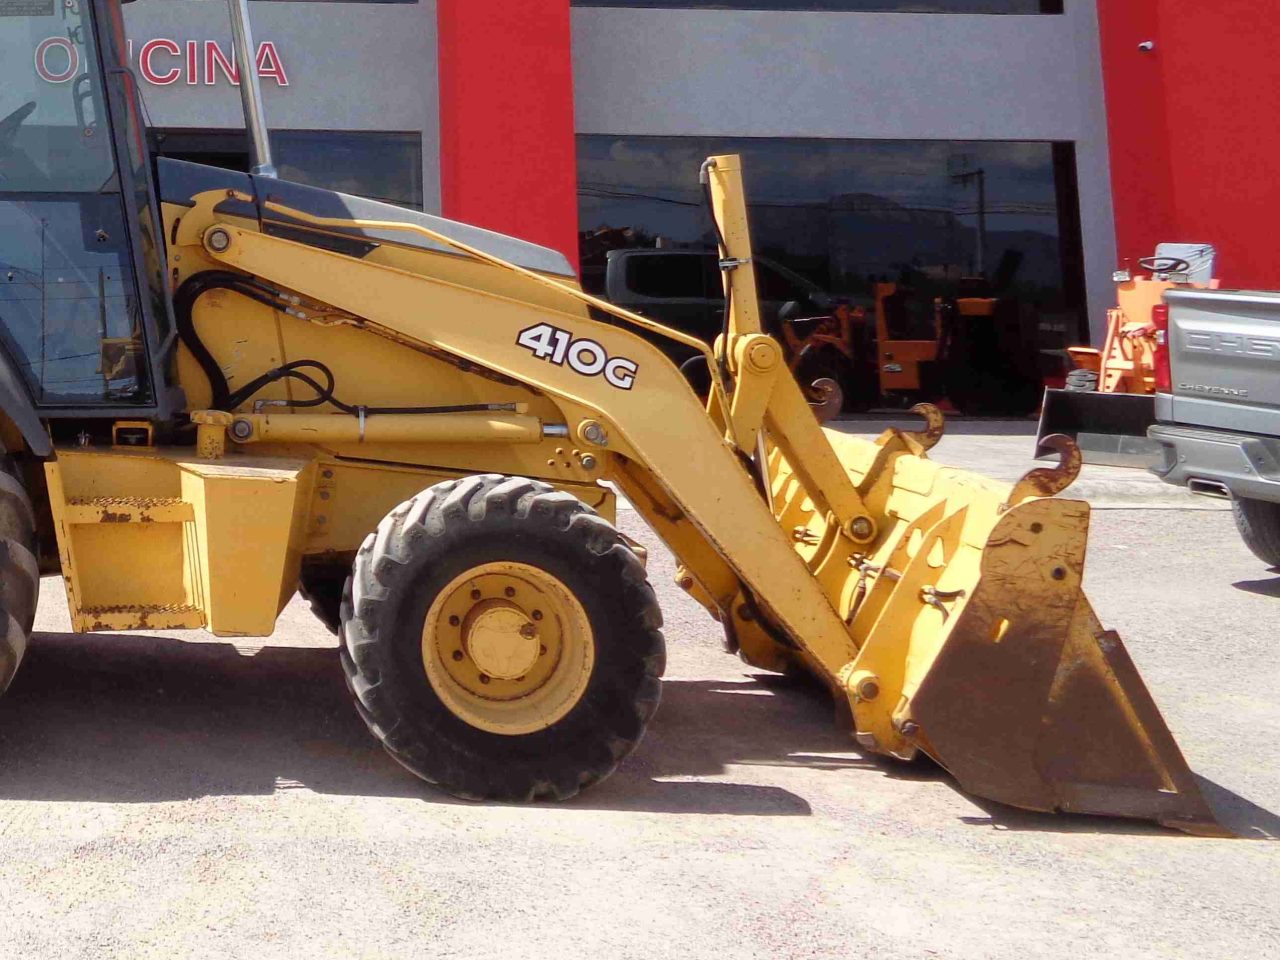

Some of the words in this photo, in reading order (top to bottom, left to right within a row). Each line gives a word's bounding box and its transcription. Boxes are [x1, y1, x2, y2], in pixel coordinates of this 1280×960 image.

[35, 36, 289, 86] OCINA
[516, 321, 639, 390] 410G
[1185, 331, 1280, 357] CHE
[1179, 382, 1248, 398] CHEYENNE
